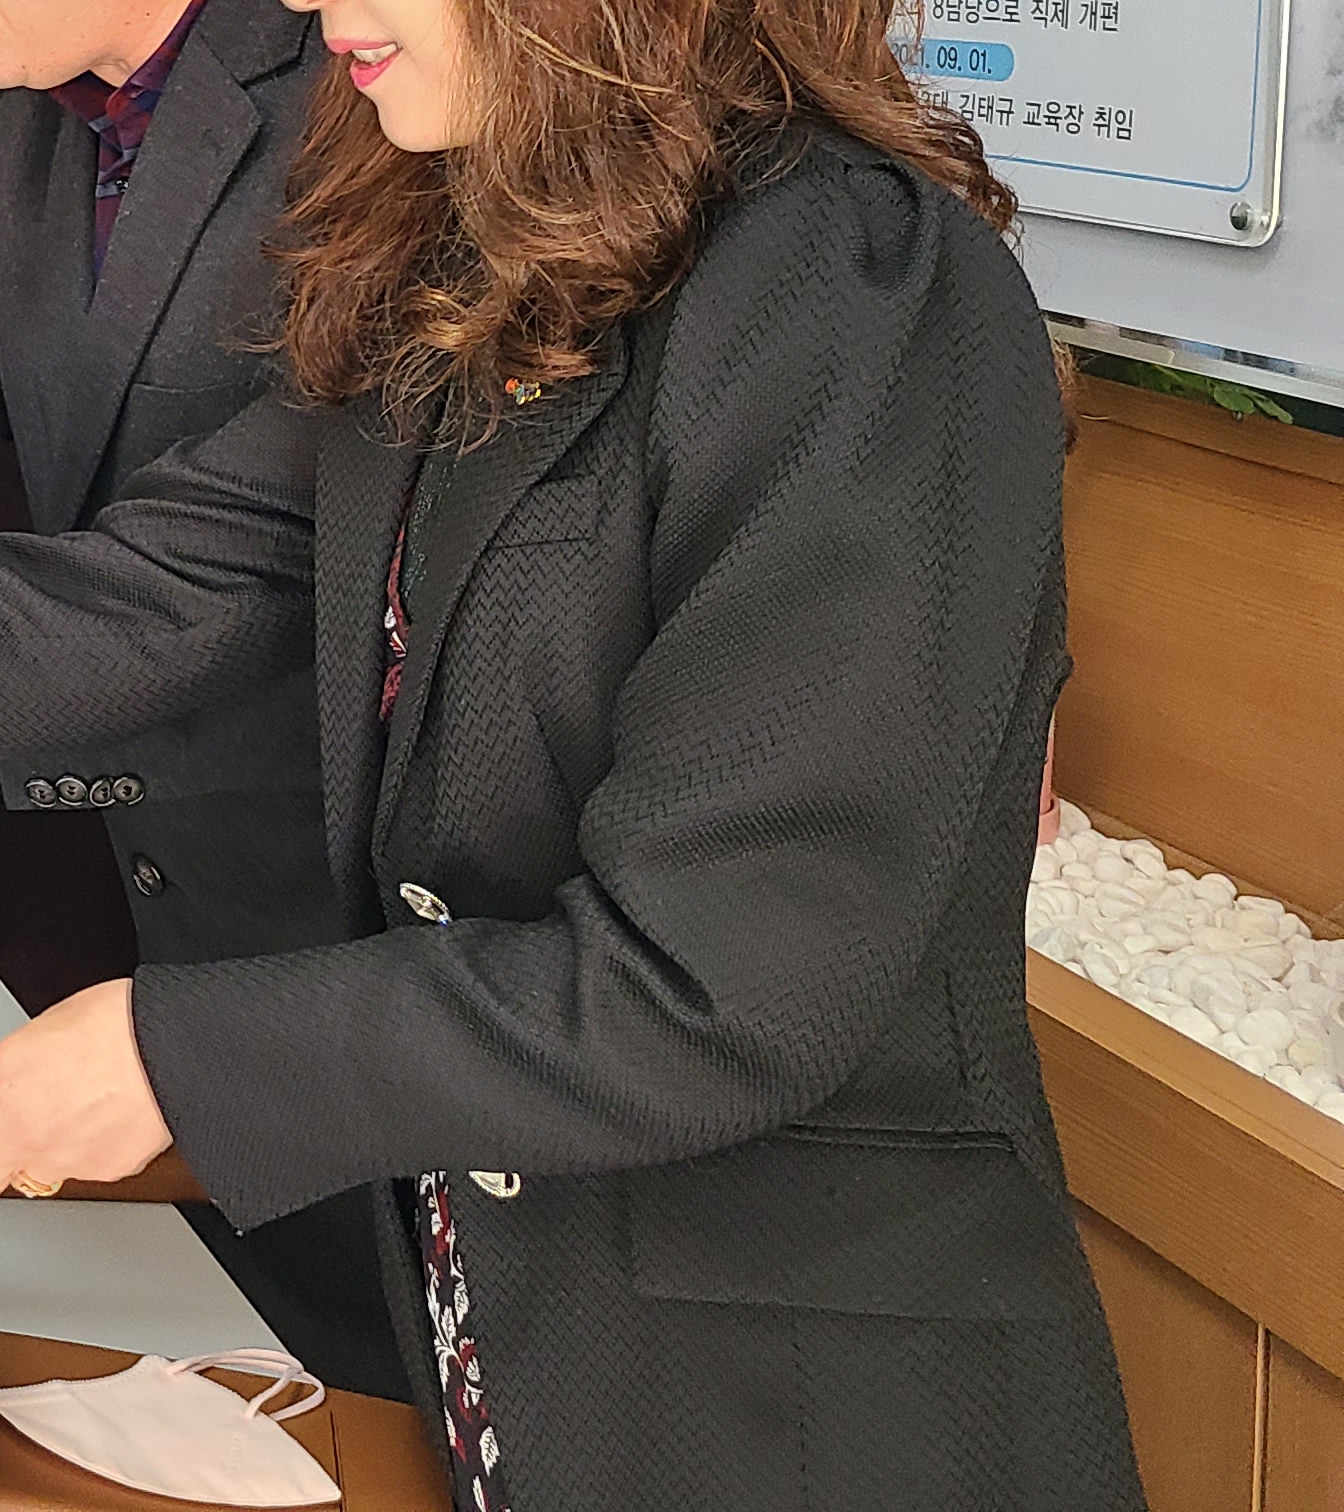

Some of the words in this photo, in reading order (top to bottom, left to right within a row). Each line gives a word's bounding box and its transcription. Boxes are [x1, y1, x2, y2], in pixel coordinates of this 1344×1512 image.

[1078, 0, 1121, 32] 개편
[937, 46, 962, 72] 09.
[969, 48, 992, 74] 01.
[959, 93, 1015, 127] 김태규
[1023, 100, 1084, 136] 교육장
[1092, 105, 1135, 141] 취임
